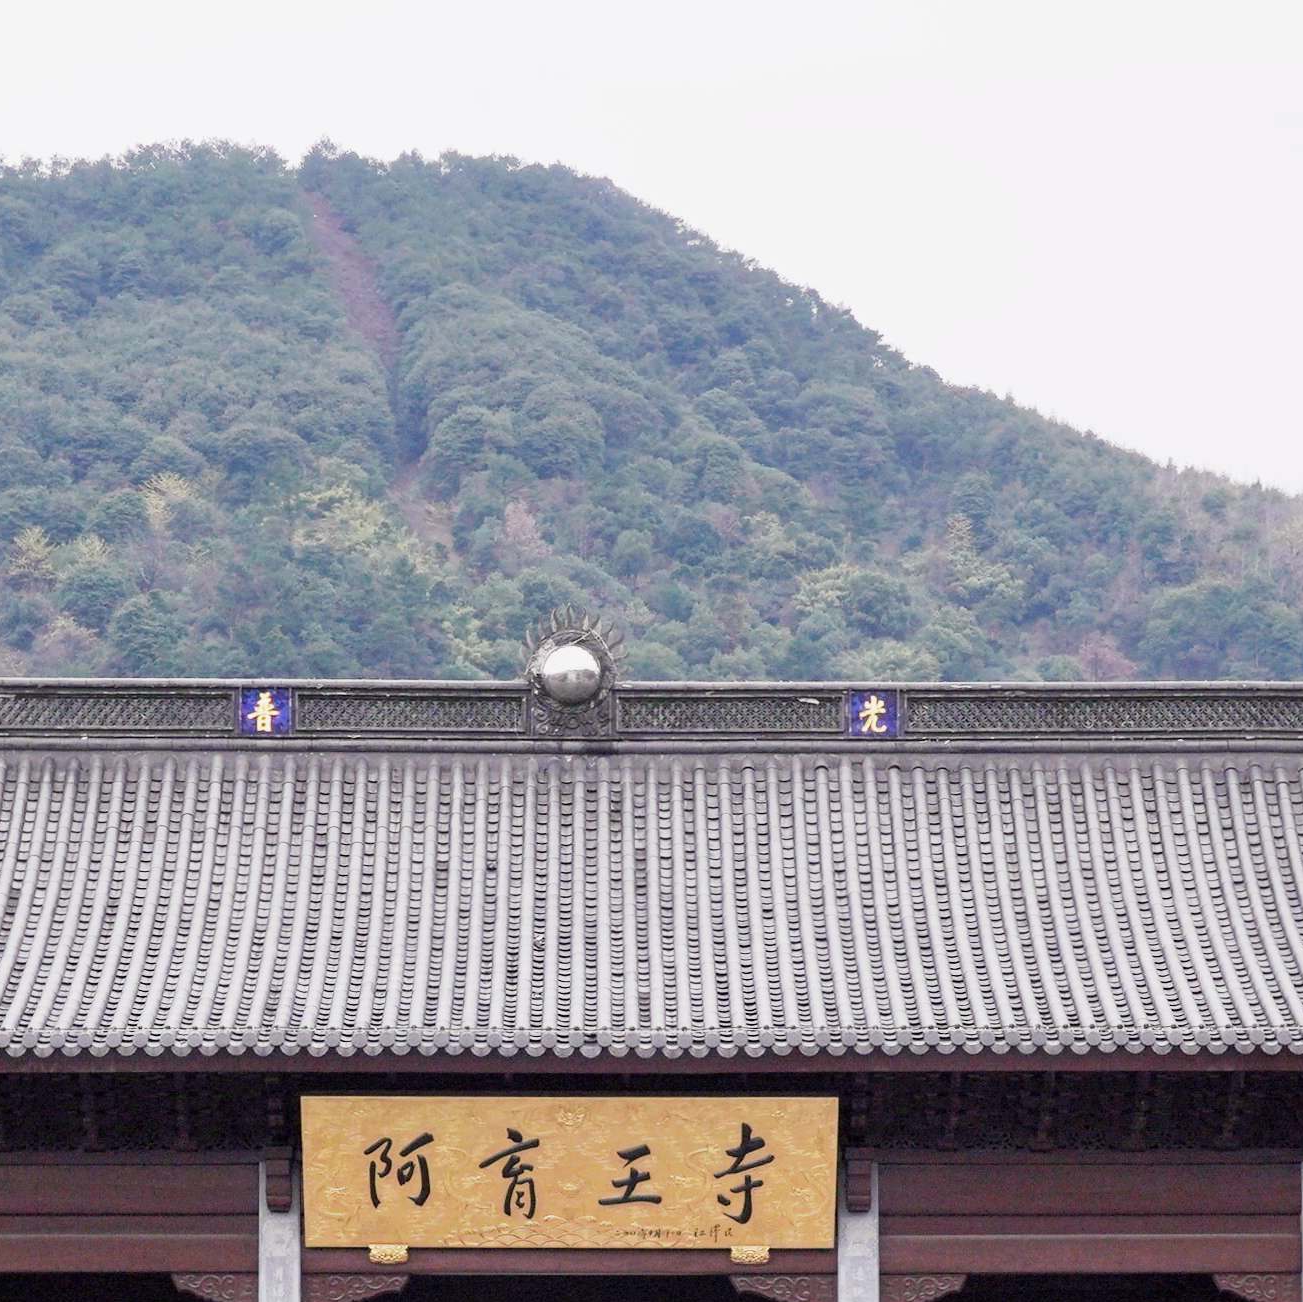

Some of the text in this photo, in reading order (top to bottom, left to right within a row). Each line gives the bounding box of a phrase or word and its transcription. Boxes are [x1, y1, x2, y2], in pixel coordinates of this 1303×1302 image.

[246, 691, 281, 732] 普
[858, 694, 888, 733] 光
[363, 1122, 775, 1225] 阿育王寺
